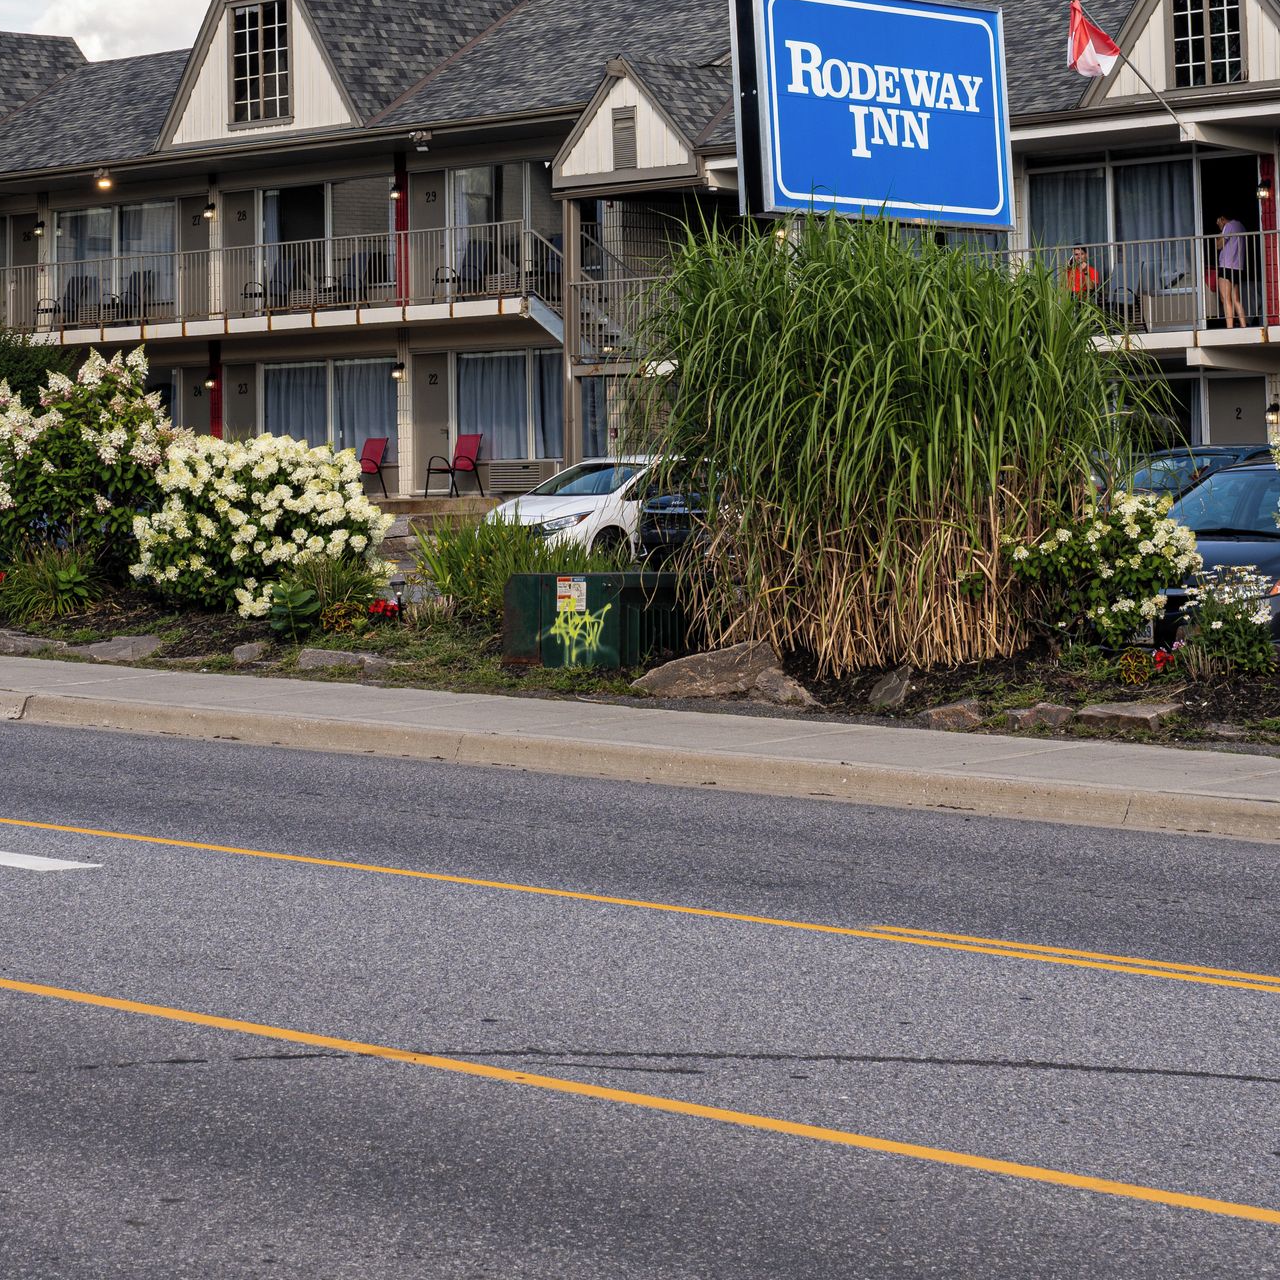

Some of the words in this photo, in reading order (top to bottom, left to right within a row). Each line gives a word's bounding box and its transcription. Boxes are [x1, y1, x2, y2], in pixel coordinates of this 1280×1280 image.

[784, 39, 983, 113] RODEWAY
[848, 104, 931, 159] INN
[425, 191, 437, 203] 29
[192, 215, 201, 226] 27
[237, 210, 247, 222] 28
[428, 373, 439, 385] 22
[1235, 407, 1242, 420] 2
